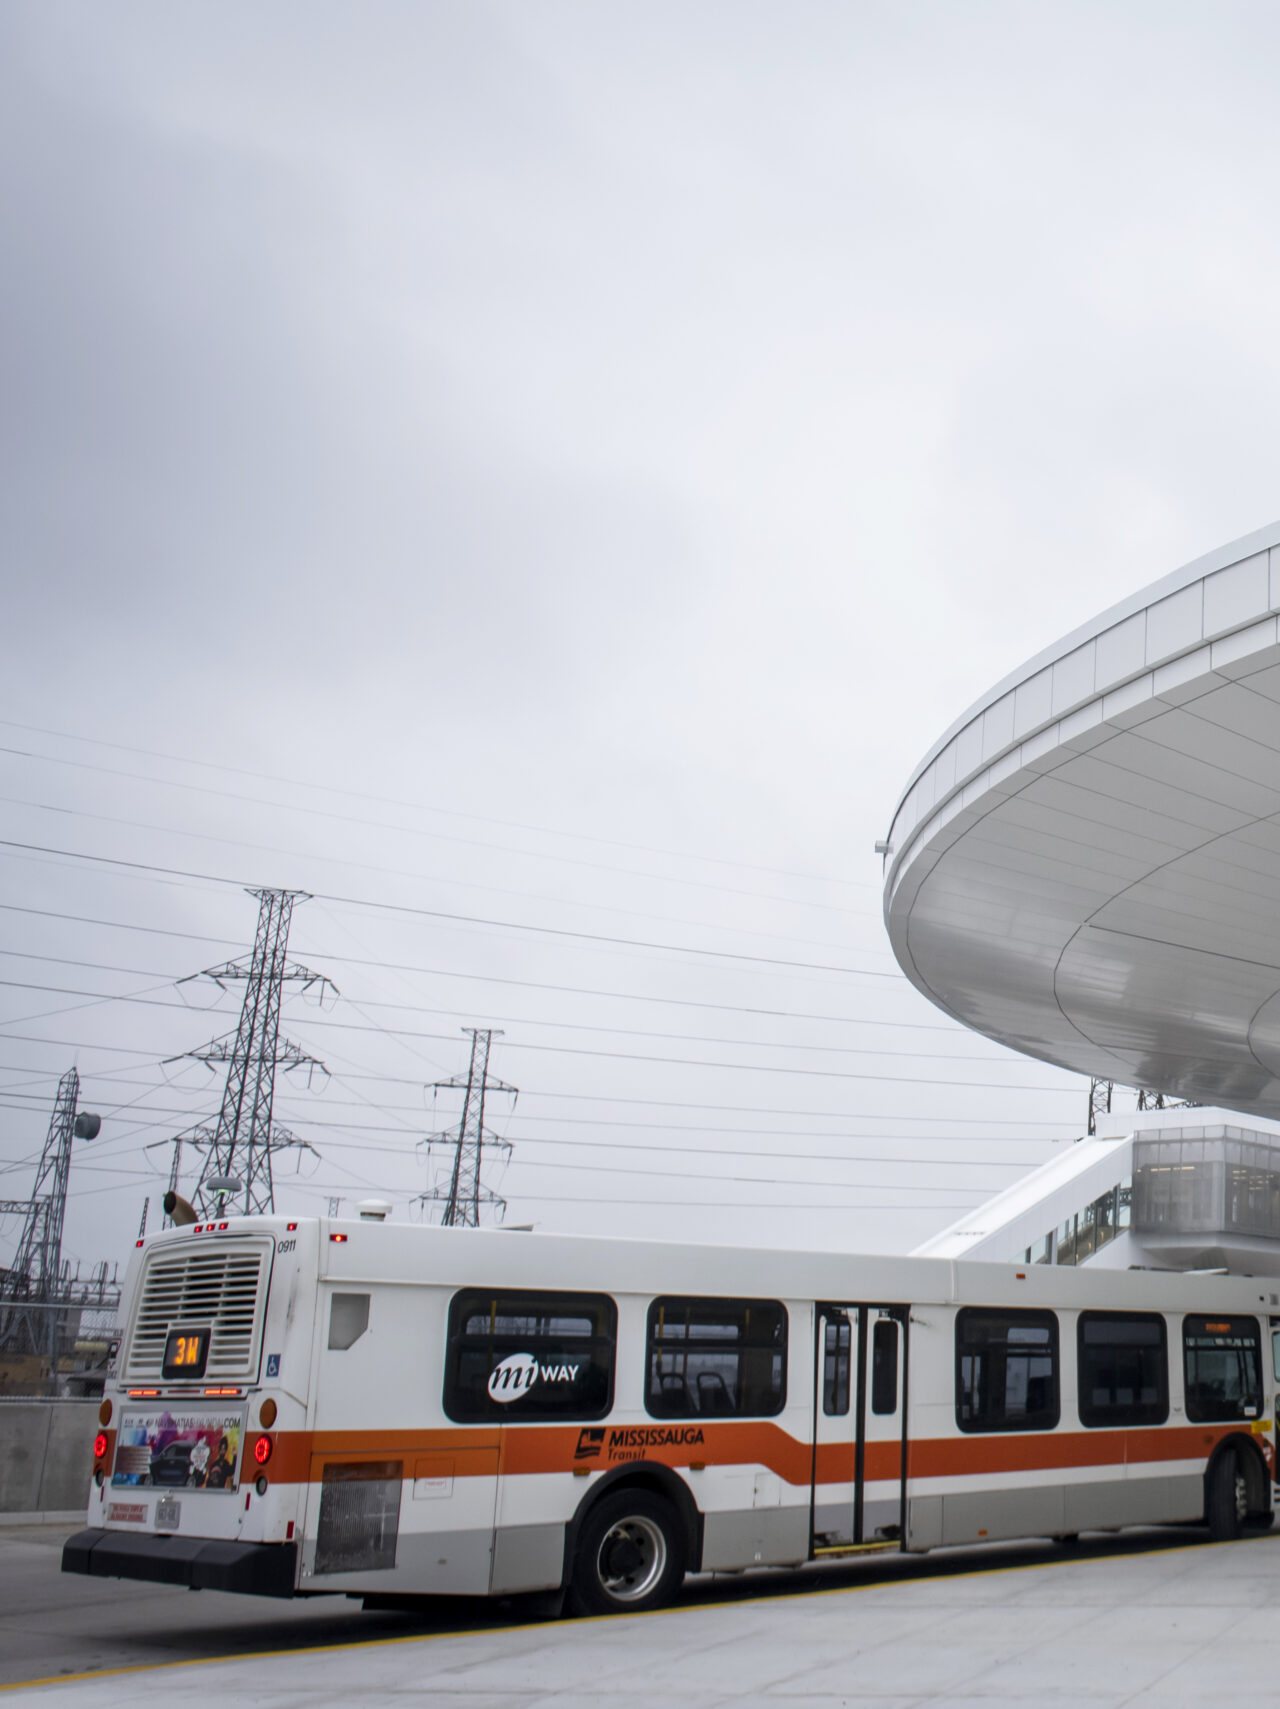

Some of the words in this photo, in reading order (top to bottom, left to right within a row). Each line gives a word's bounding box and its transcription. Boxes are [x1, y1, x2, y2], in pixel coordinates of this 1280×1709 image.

[277, 1239, 296, 1253] 0911
[609, 1428, 705, 1447] MISSISSAUGA
[608, 1448, 646, 1461] Transit
